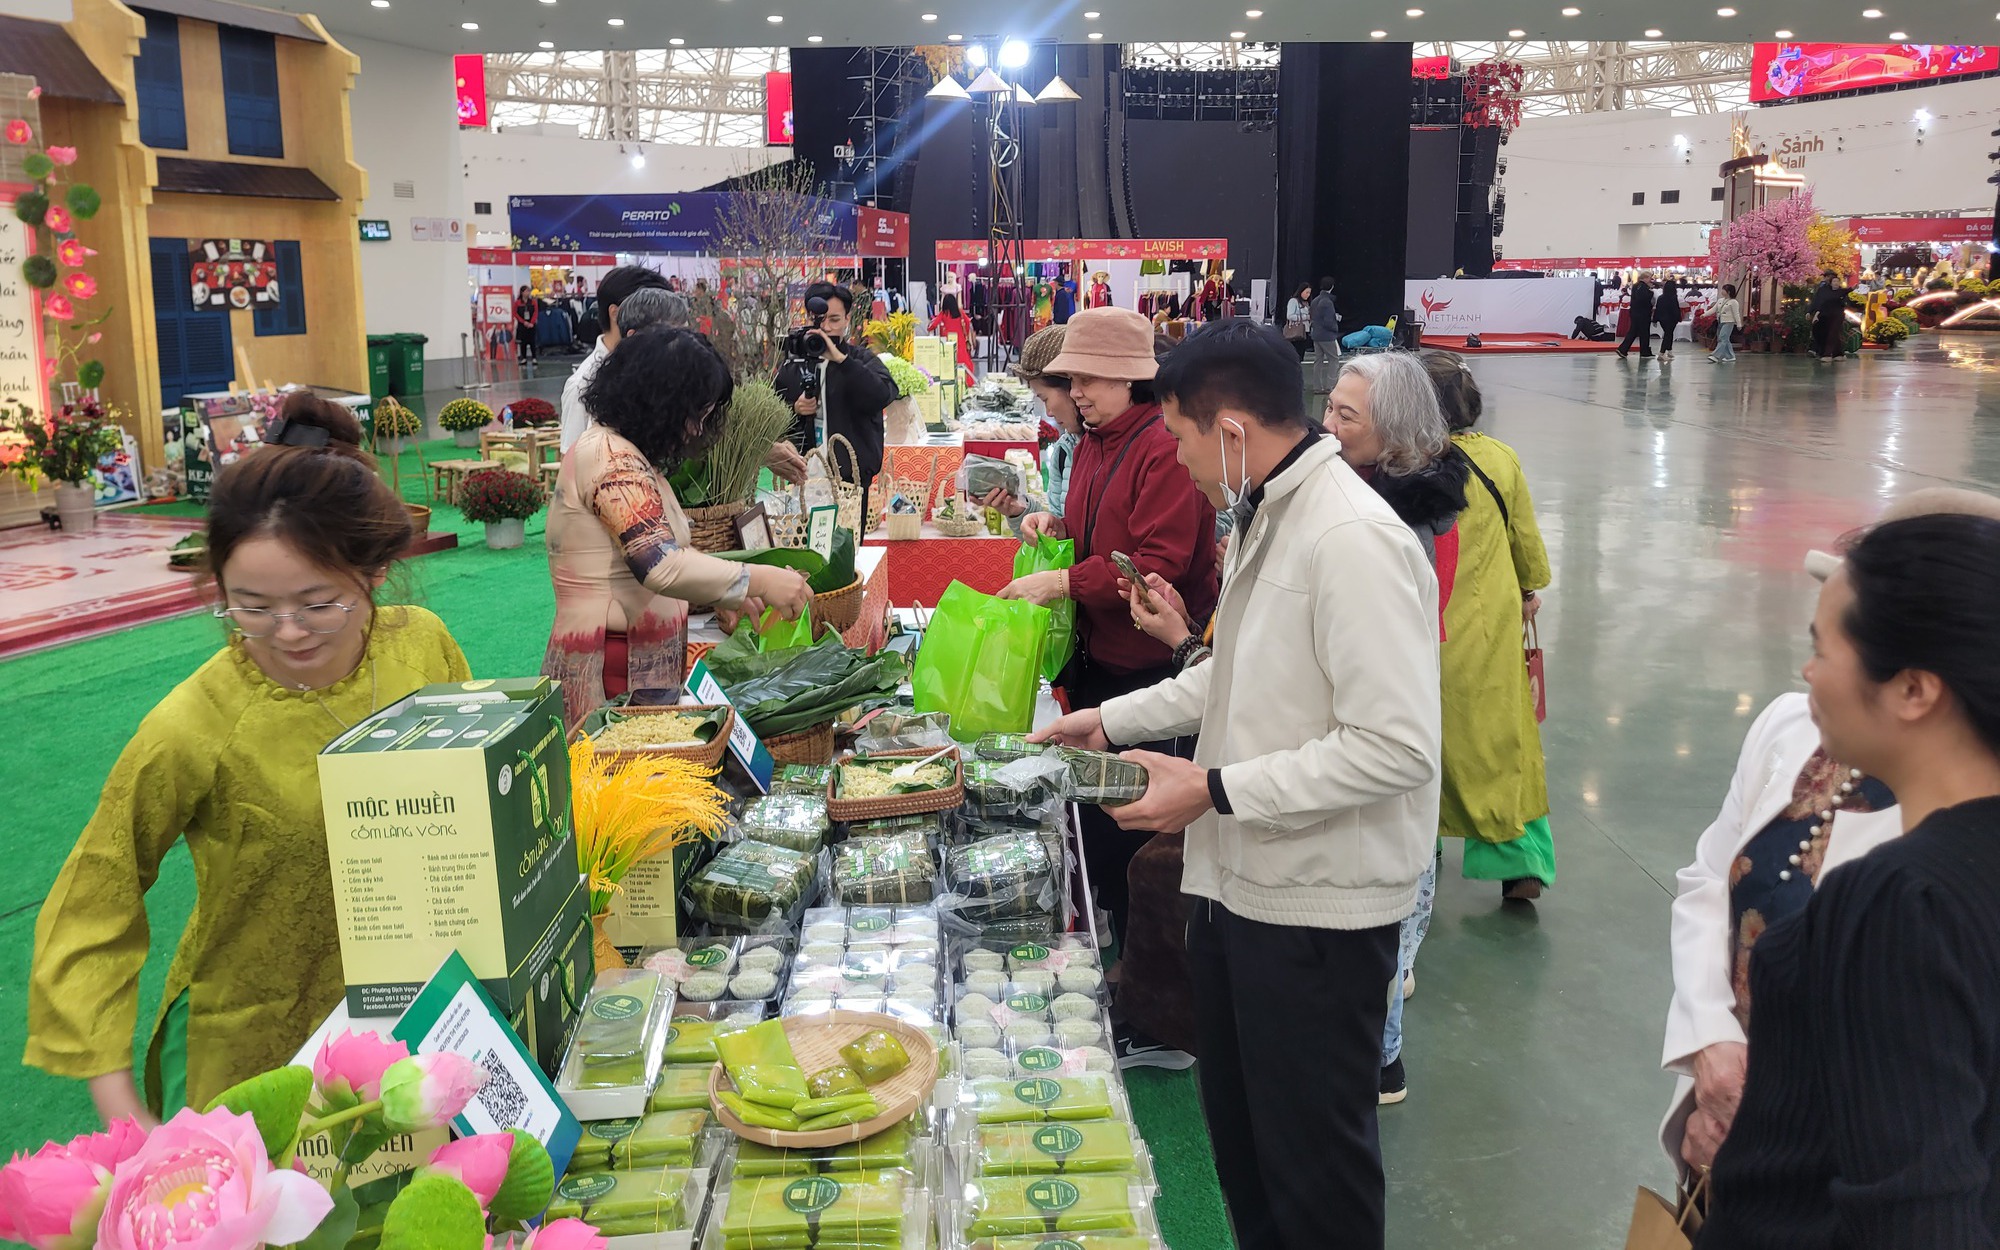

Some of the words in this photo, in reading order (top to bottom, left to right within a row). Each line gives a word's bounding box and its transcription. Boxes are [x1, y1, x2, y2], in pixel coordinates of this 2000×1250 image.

[1781, 135, 1824, 154] Sảnh
[1781, 156, 1805, 169] Hall
[622, 210, 670, 221] PERATO
[1966, 222, 1978, 231] ĐÁ
[1145, 241, 1184, 252] LAVISH
[347, 797, 389, 819] MỘC
[396, 791, 455, 815] HUYỀN
[351, 824, 381, 840] CỐM
[384, 824, 413, 838] LÀNG
[416, 822, 457, 837] VÒNG
